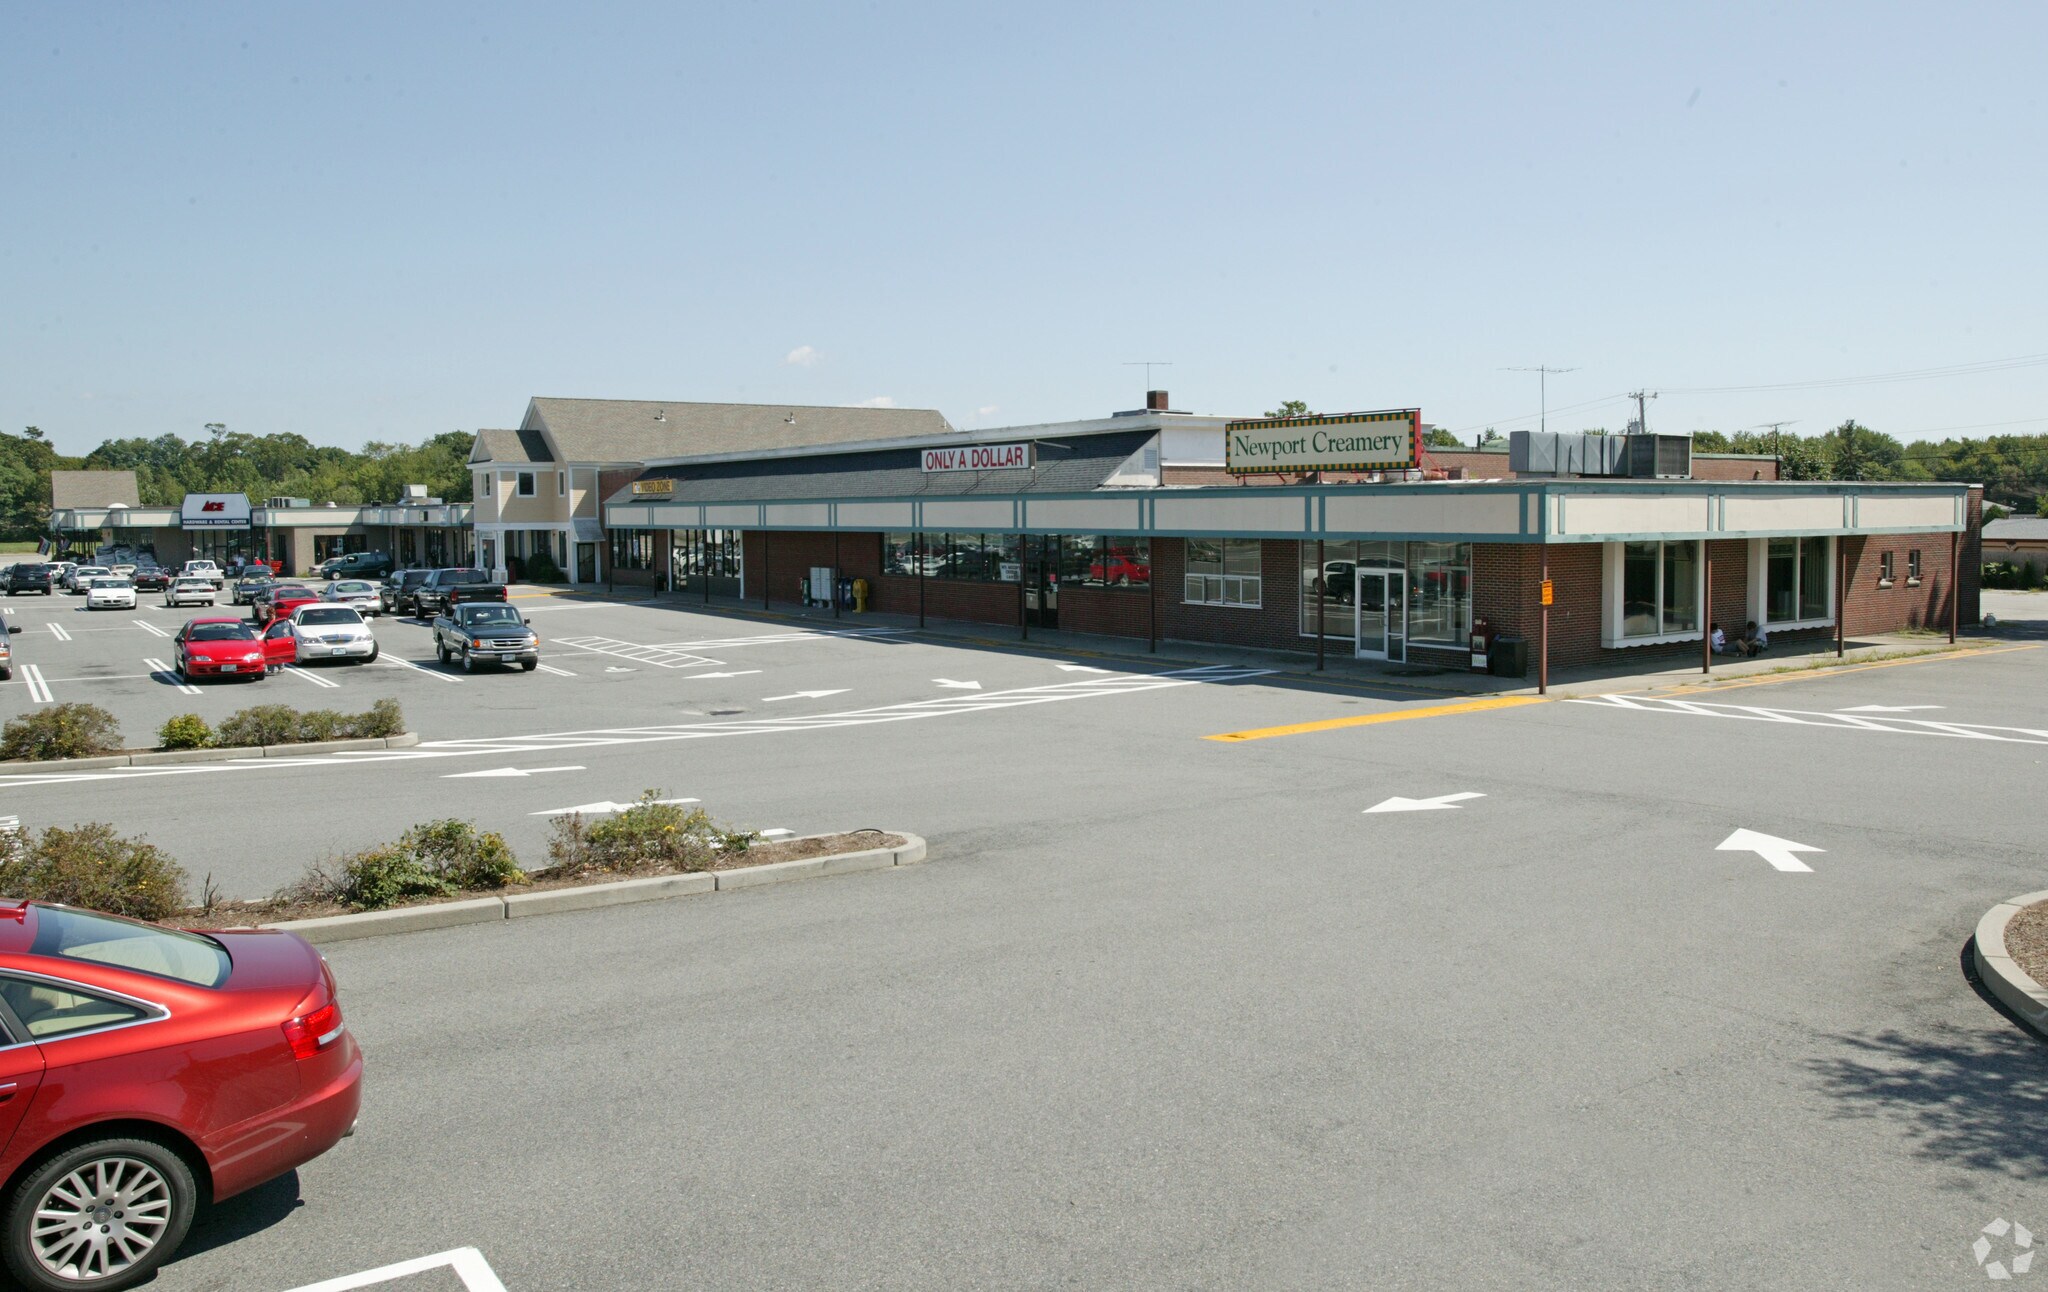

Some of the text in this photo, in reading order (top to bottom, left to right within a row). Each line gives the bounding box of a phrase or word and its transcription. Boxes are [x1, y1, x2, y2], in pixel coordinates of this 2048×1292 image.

[1234, 431, 1403, 460] Newport Creamery
[926, 447, 1023, 470] ONLY A DOLLAR
[640, 480, 670, 492] VIDEO ZONE
[202, 500, 225, 512] ACE
